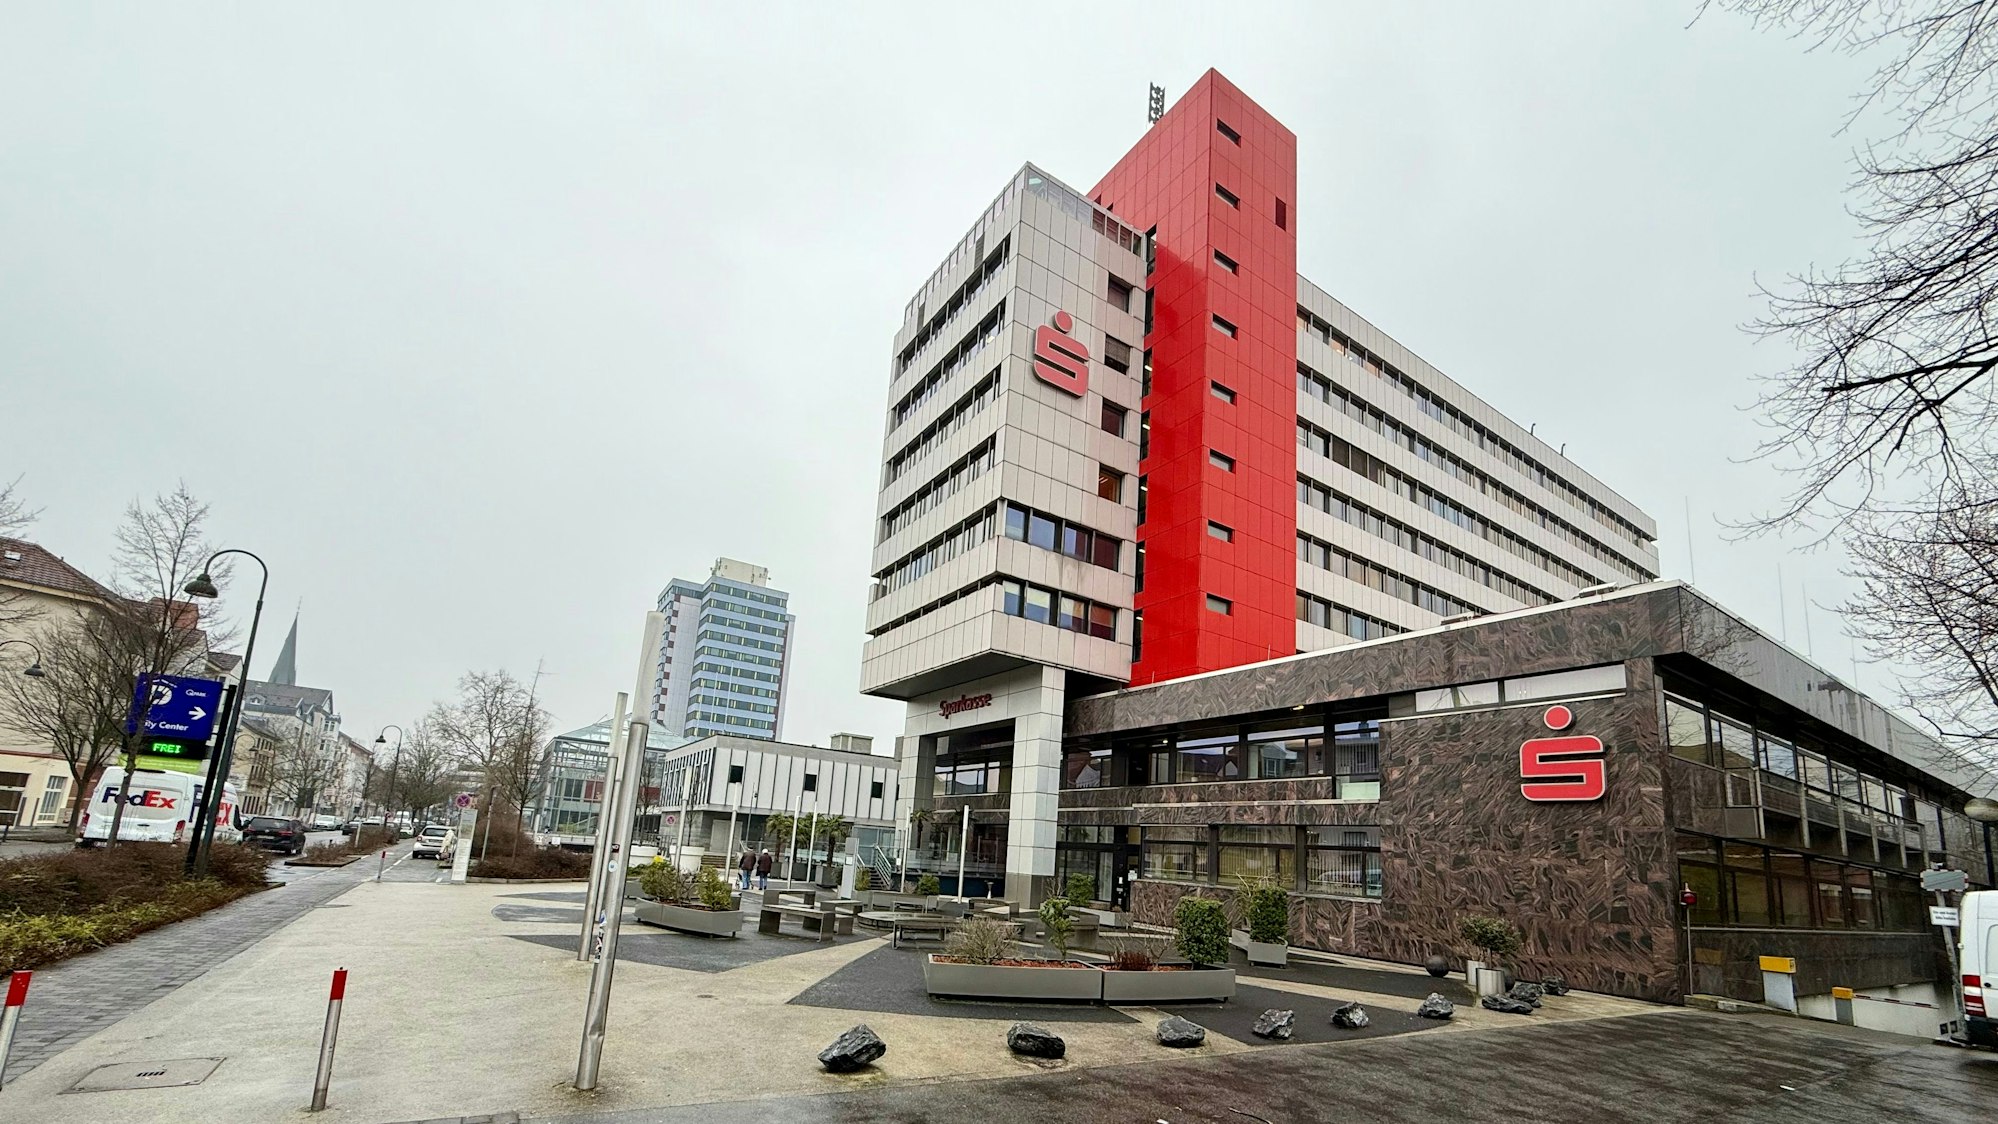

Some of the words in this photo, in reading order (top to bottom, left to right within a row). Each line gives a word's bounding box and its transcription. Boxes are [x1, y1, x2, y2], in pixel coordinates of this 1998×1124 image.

[939, 693, 993, 719] Sparkasse
[159, 721, 189, 731] Center
[152, 743, 182, 753] FREI
